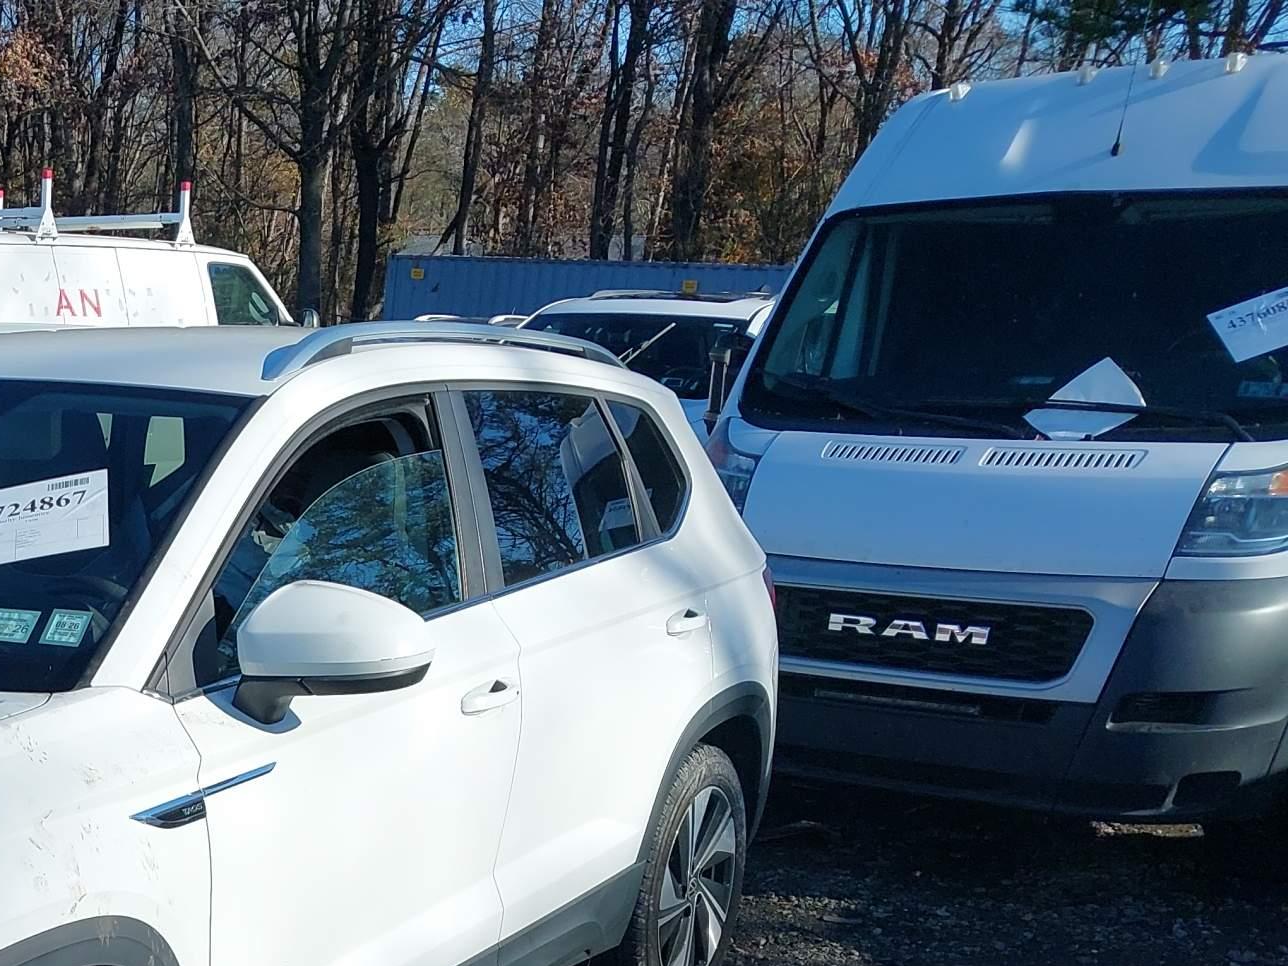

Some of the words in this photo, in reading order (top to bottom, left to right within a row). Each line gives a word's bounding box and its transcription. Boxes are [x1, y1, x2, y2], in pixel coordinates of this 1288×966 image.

[55, 289, 103, 317] AN
[12, 624, 30, 634] 26
[828, 613, 991, 645] RAM
